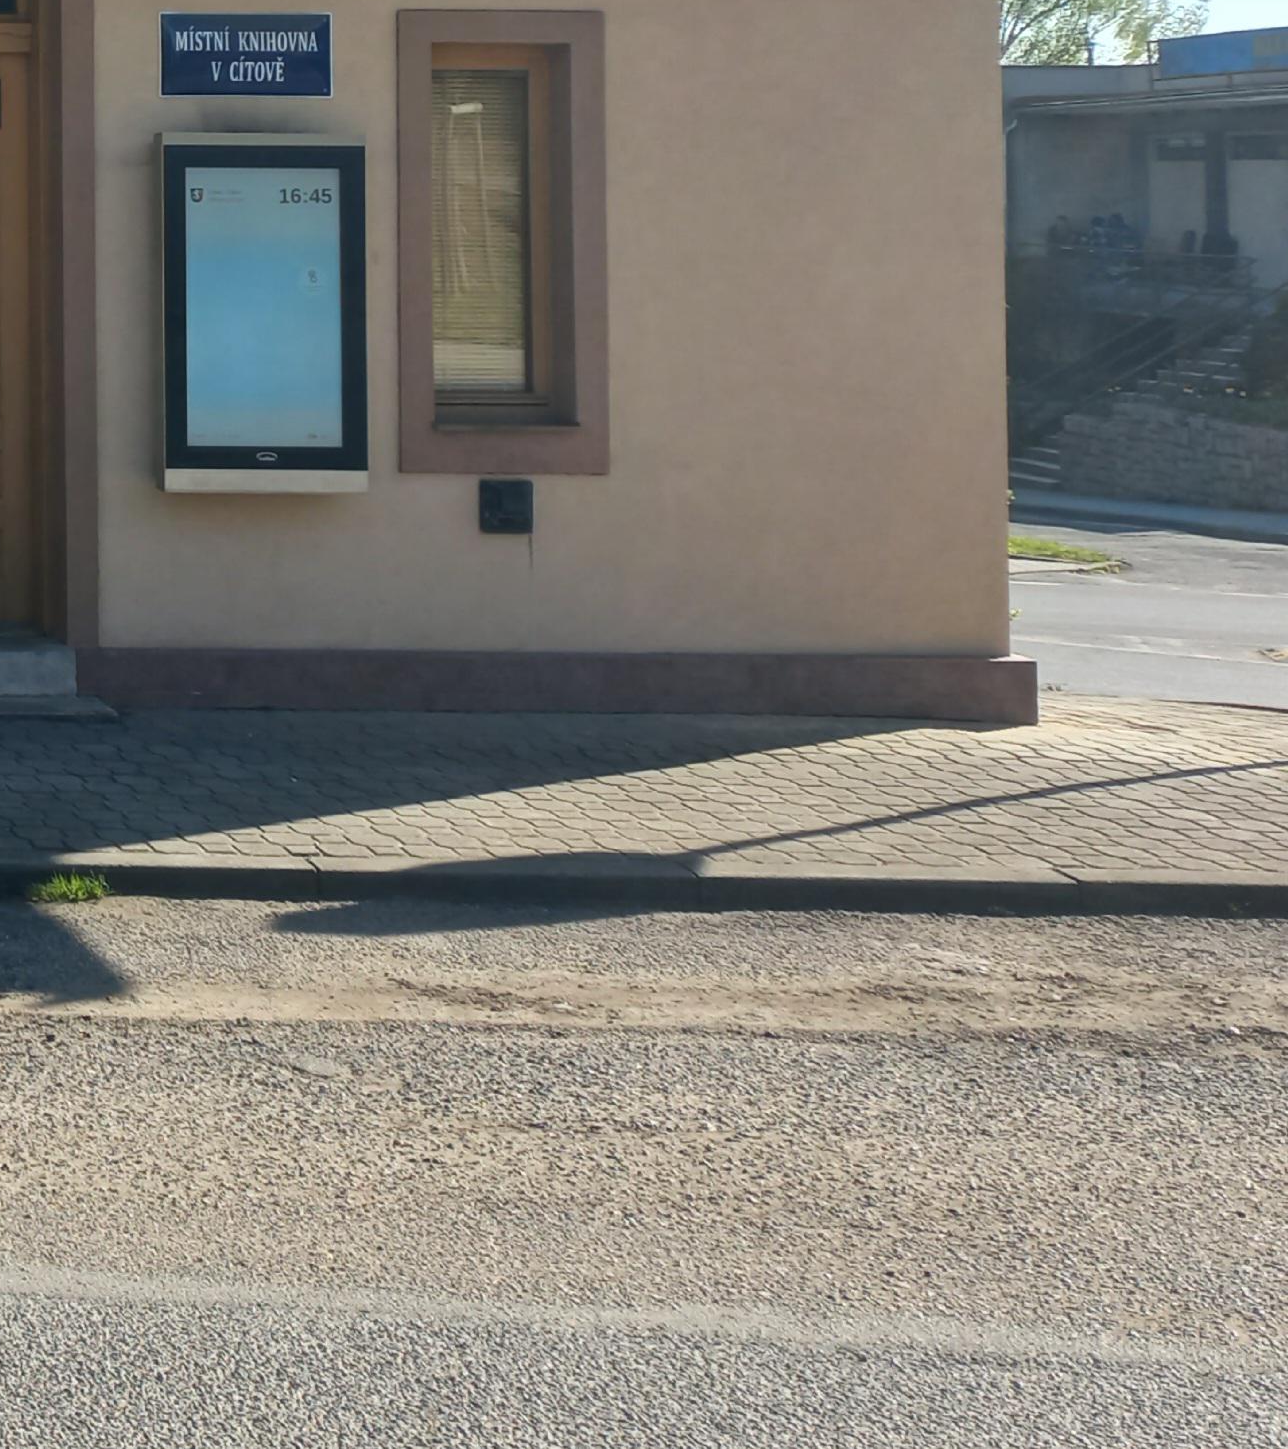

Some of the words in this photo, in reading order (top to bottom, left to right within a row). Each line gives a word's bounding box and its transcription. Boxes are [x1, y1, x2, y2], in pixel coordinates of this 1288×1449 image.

[175, 26, 230, 51] MÍSTNÍ
[238, 31, 318, 51] KNIHOVNA
[211, 61, 222, 82] V
[229, 56, 285, 82] CÍTOVĚ
[279, 188, 332, 204] 16:45
